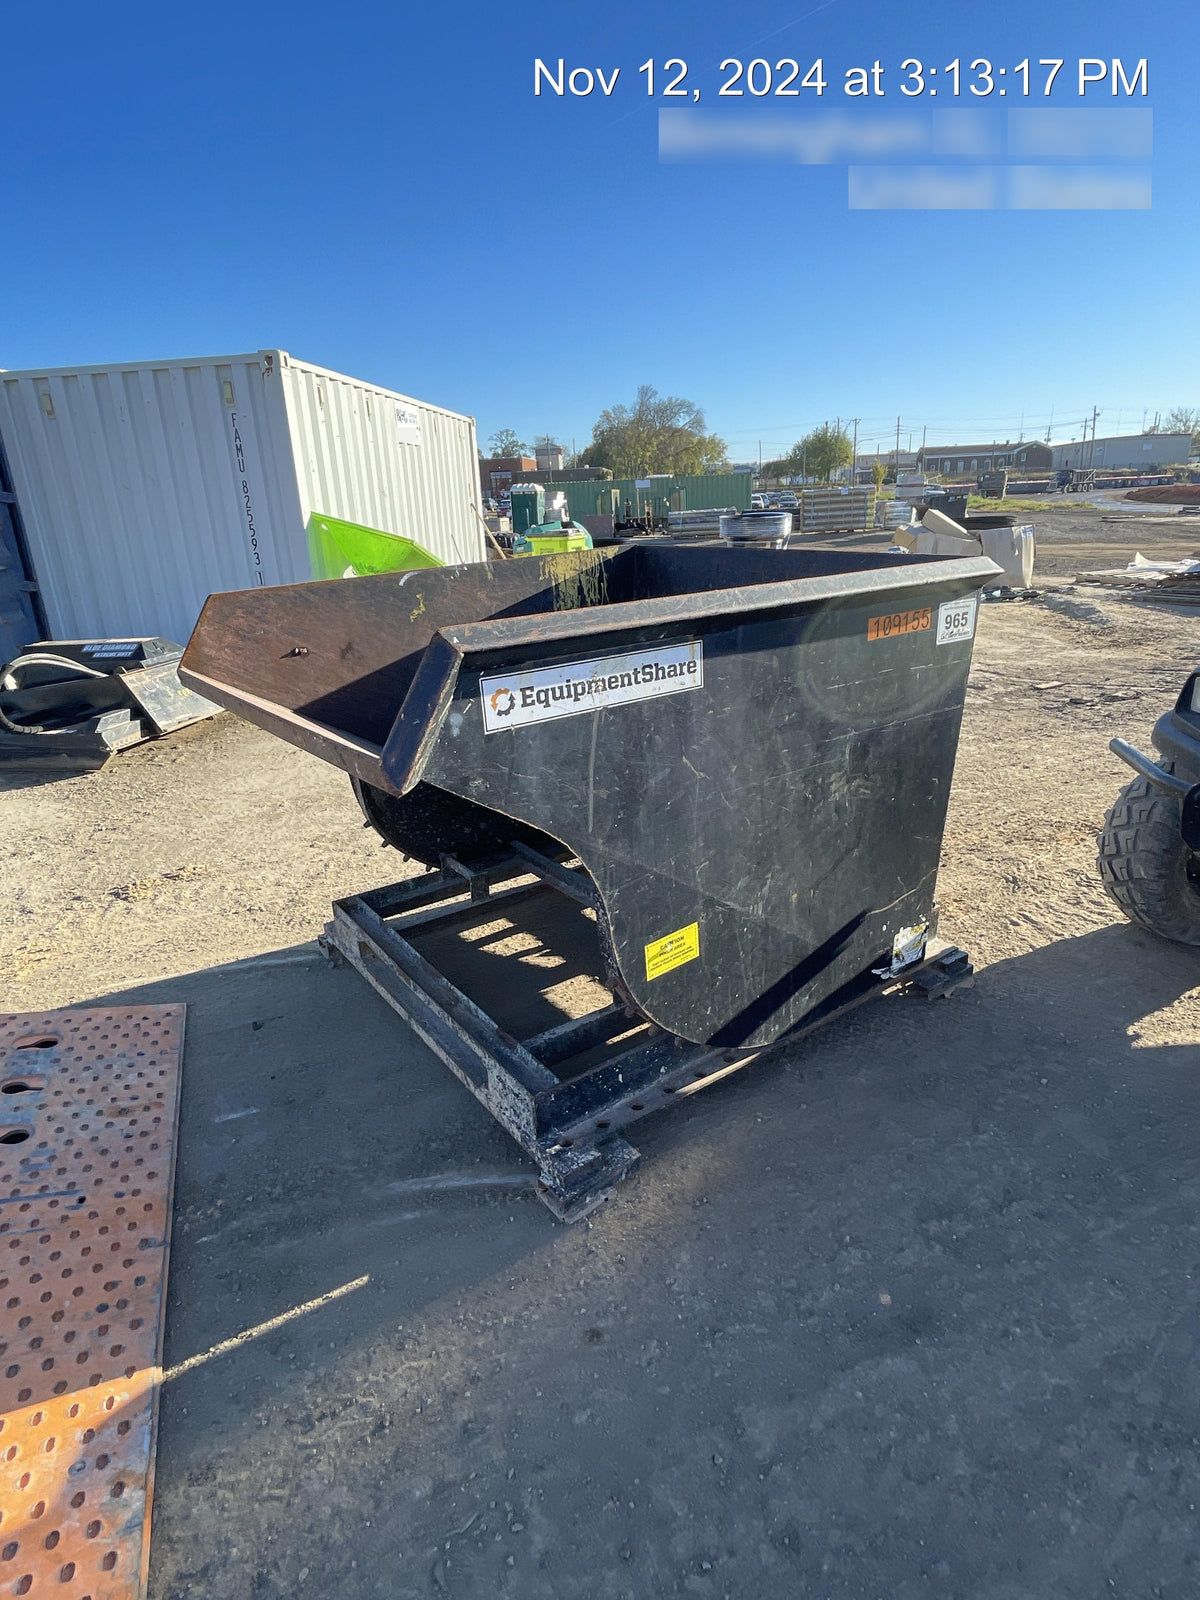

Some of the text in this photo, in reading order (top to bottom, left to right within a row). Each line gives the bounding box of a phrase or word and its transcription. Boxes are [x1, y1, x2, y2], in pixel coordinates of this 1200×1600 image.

[231, 413, 264, 585] FAMU 825593 1
[874, 610, 930, 637] 109155
[945, 612, 968, 630] 965
[82, 643, 138, 652] BLUE DIAMOND
[520, 659, 697, 708] EquipmentShare
